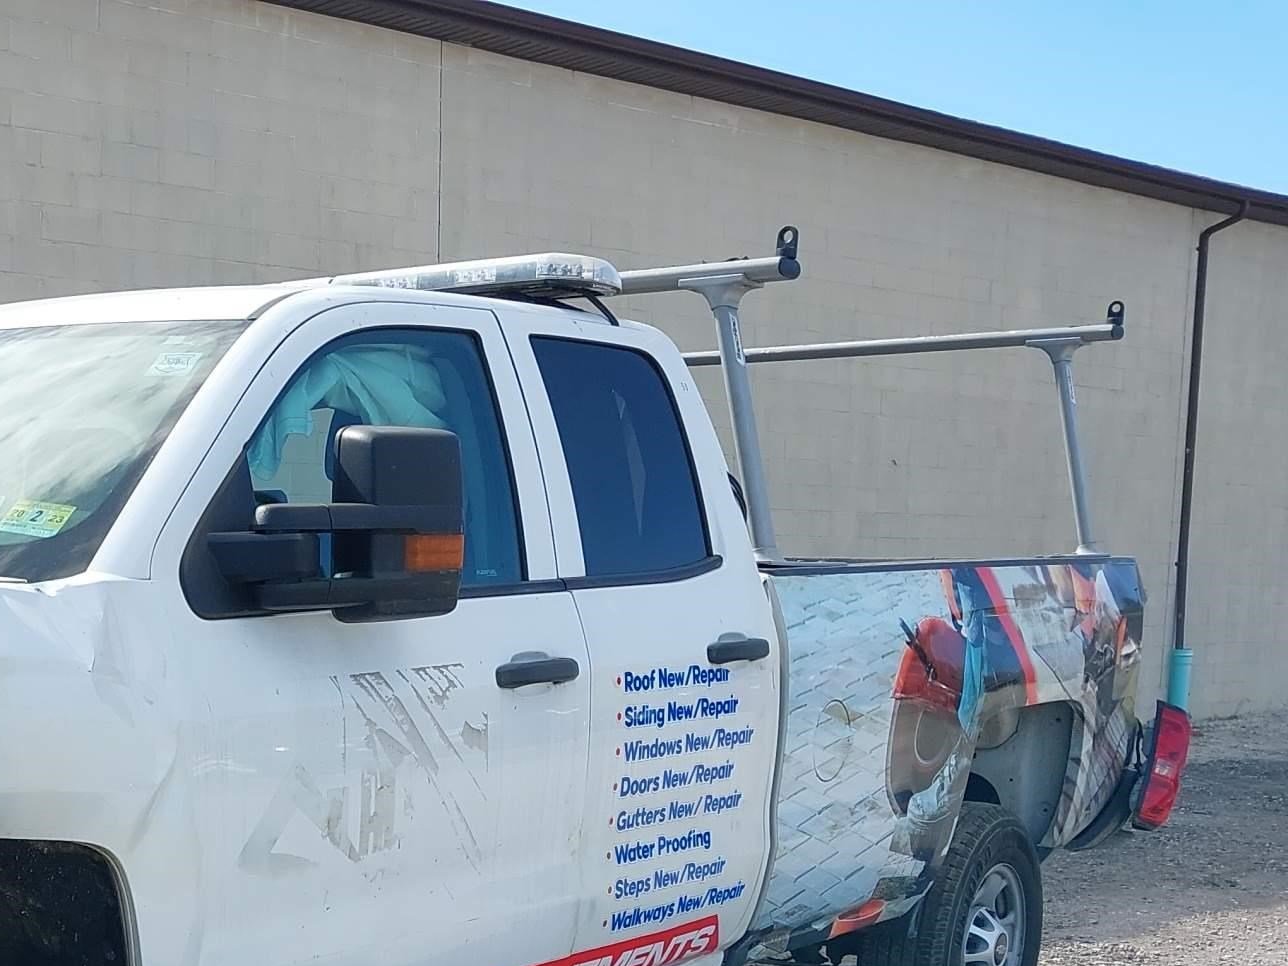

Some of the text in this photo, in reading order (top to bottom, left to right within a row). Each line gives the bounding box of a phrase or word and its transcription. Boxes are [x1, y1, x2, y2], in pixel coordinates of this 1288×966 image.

[29, 510, 44, 522] 2
[48, 514, 65, 523] 23
[623, 664, 730, 692] Roof New/Repair
[624, 695, 739, 728] Siding New/Repair
[624, 725, 754, 762] Windows New/Repair
[620, 762, 734, 797] Doors New/Repair
[616, 807, 667, 832] Gutters
[615, 830, 711, 865] Water Proofing
[615, 860, 726, 899] Steps New/Repair
[611, 882, 744, 931] Walkways New/Repair
